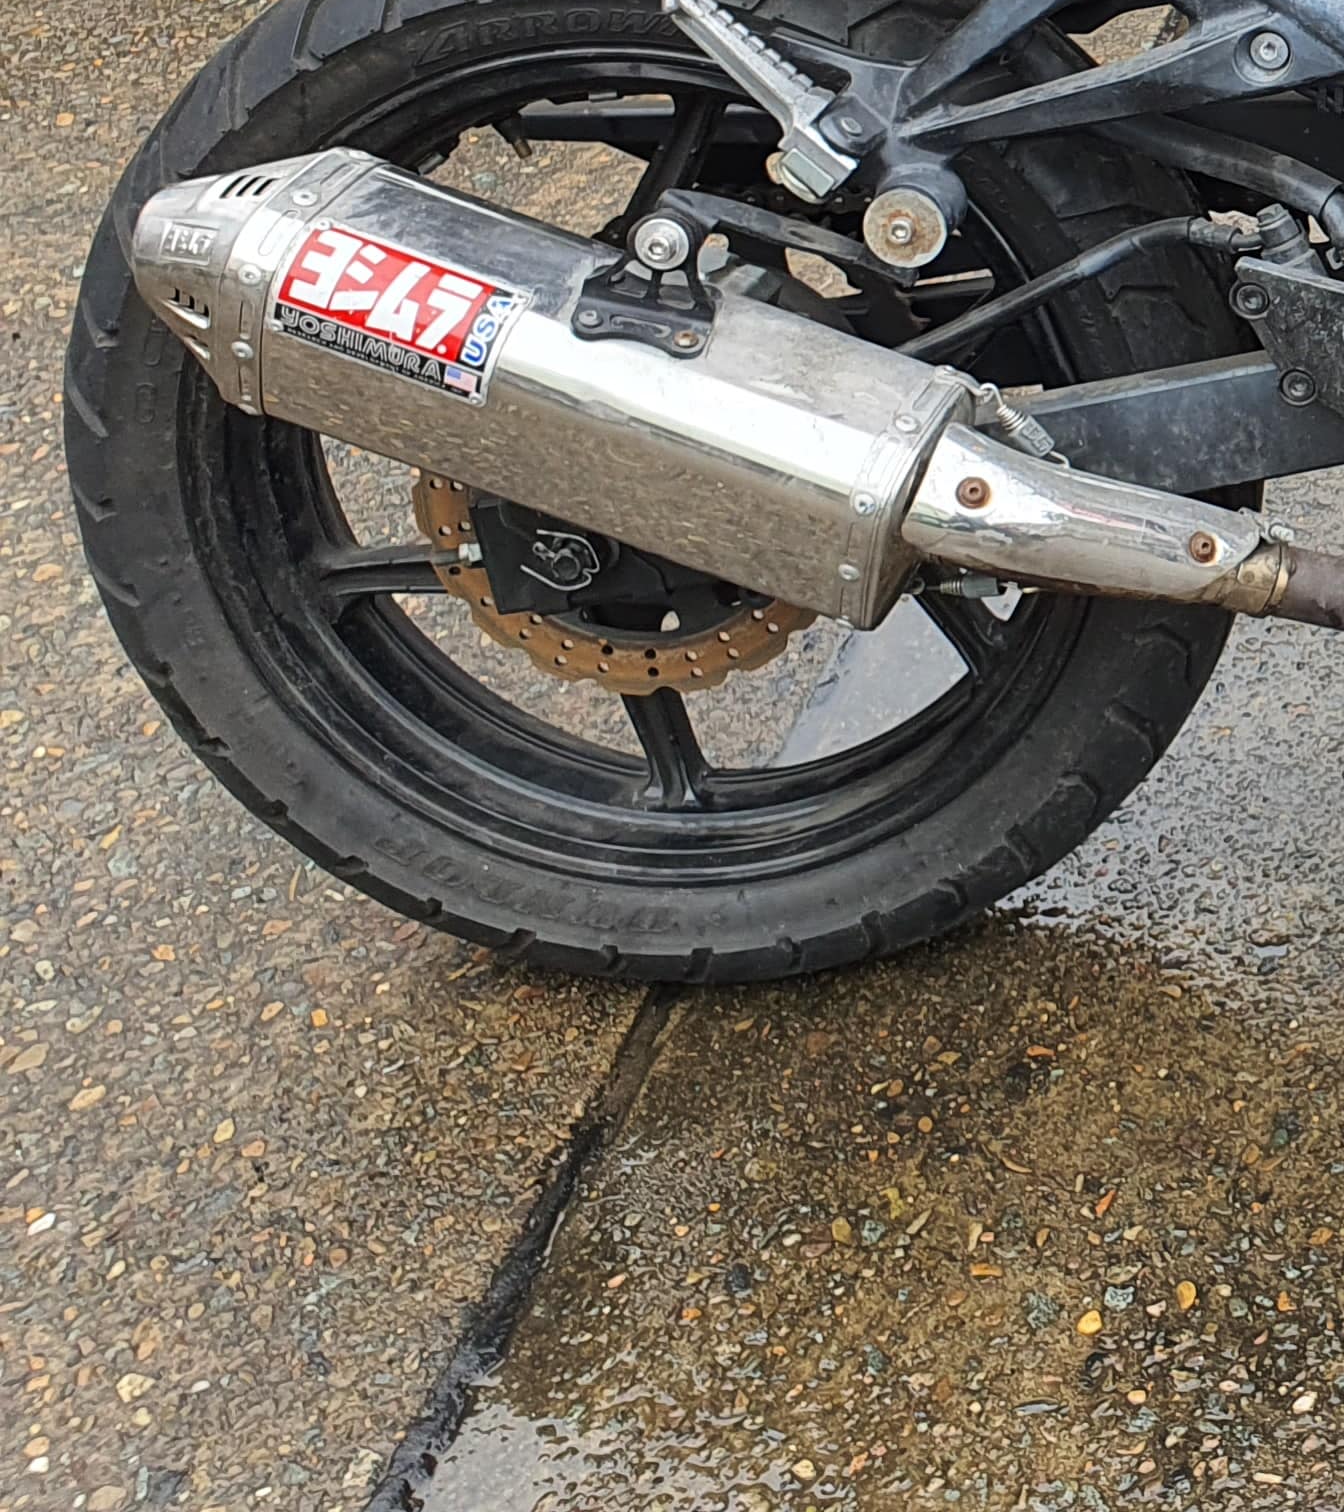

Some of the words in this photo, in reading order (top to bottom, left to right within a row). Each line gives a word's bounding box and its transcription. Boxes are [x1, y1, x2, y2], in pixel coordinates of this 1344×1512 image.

[288, 229, 484, 352] ヨシムラ
[280, 305, 442, 381] YOSHIMURA
[460, 292, 518, 367] USA
